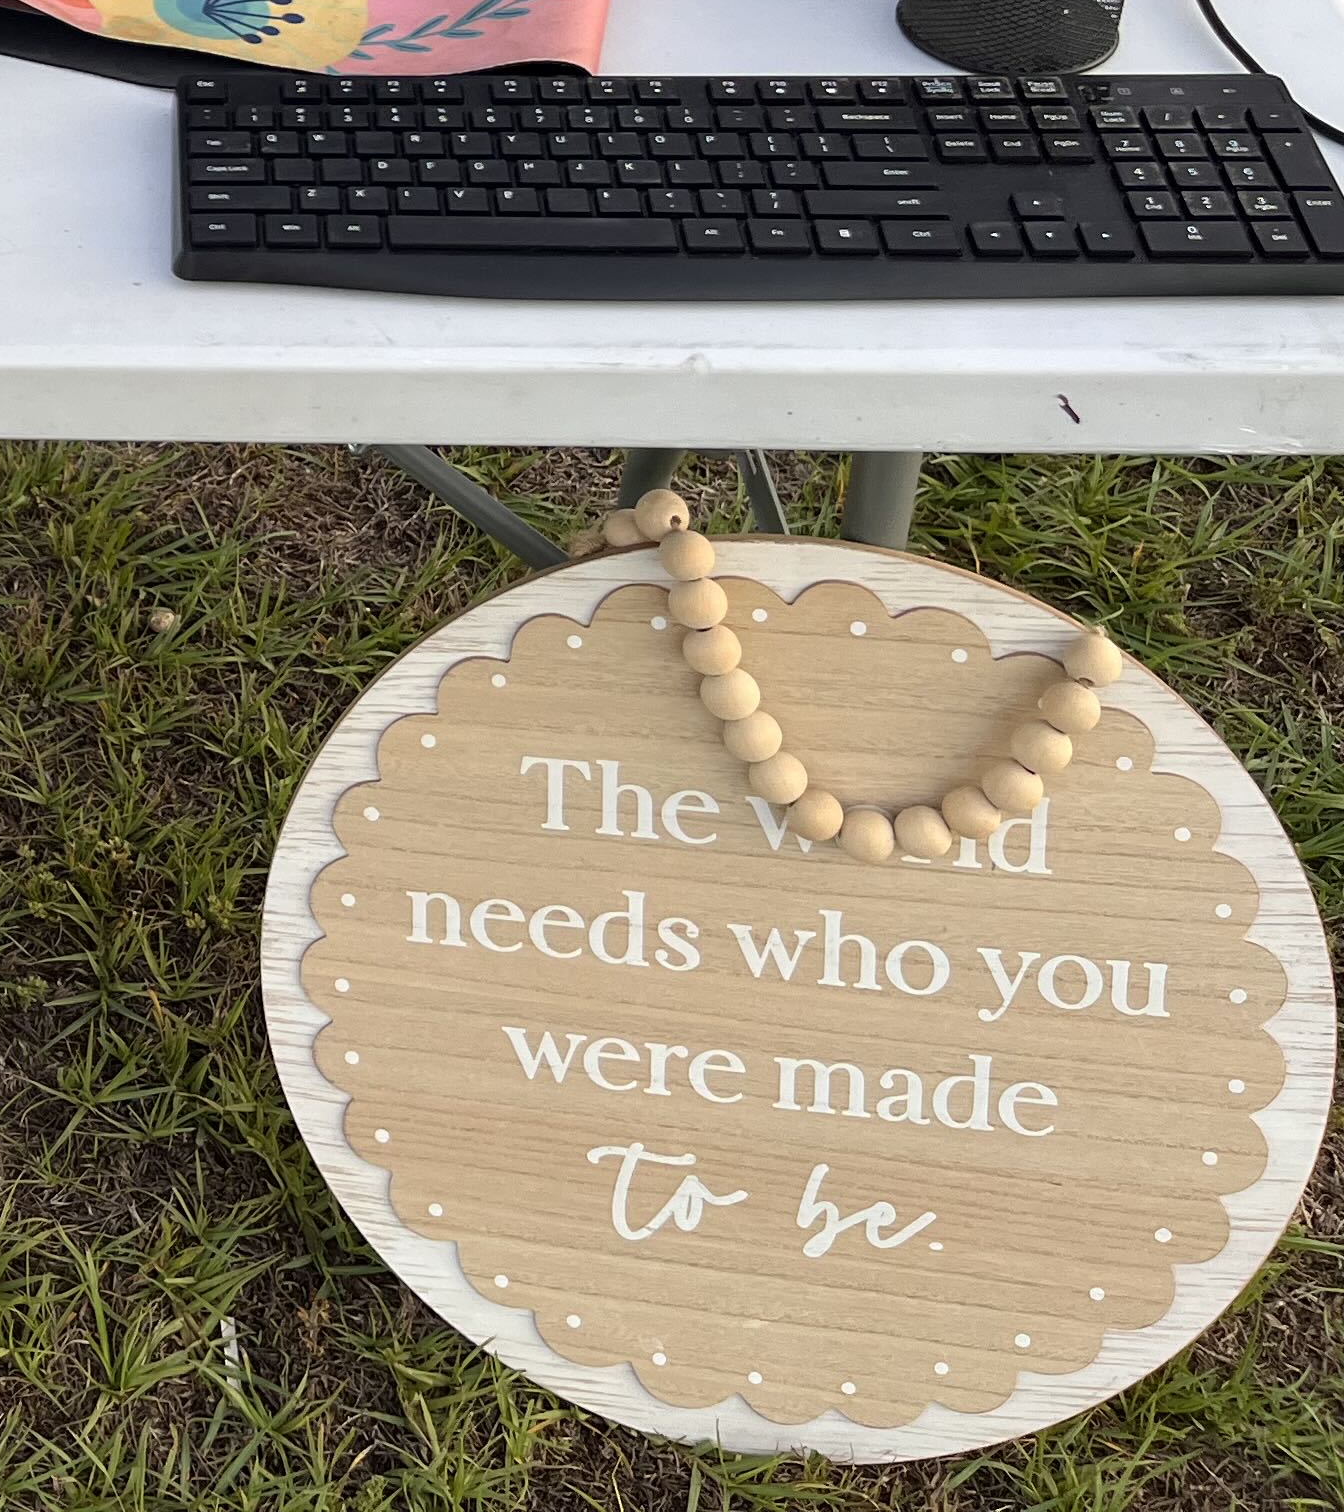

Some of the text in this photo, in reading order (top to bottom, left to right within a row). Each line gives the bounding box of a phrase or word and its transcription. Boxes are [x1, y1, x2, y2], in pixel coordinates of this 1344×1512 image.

[520, 755, 717, 844] The
[406, 889, 1171, 1022] needs who you
[502, 1025, 1059, 1138] were made
[586, 1142, 944, 1259] to be.
